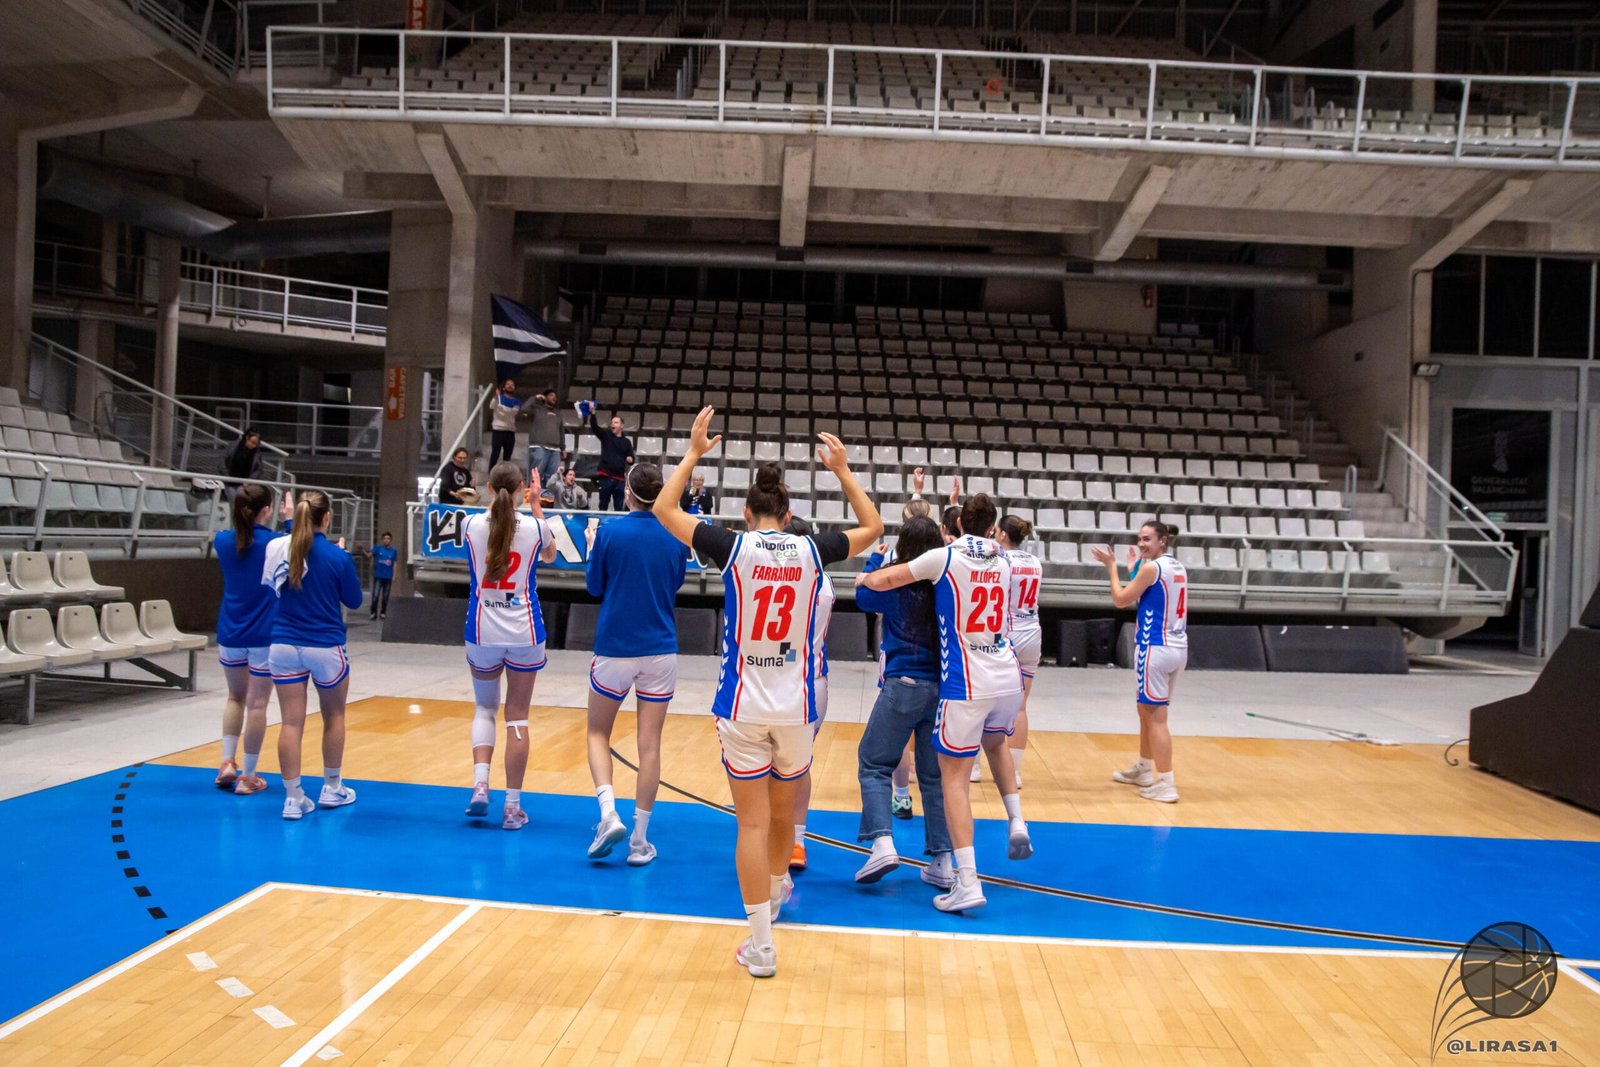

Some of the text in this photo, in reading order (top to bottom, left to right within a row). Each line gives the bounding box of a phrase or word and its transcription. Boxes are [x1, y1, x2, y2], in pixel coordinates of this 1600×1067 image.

[1472, 476, 1528, 485] GENERALITAT
[751, 564, 802, 582] FARRANDO
[970, 569, 1001, 584] M.LÓPEZ
[1017, 578, 1039, 609] 14
[1176, 587, 1185, 619] 4
[751, 585, 796, 641] 13
[966, 586, 1004, 633] 23
[746, 655, 784, 667] suma
